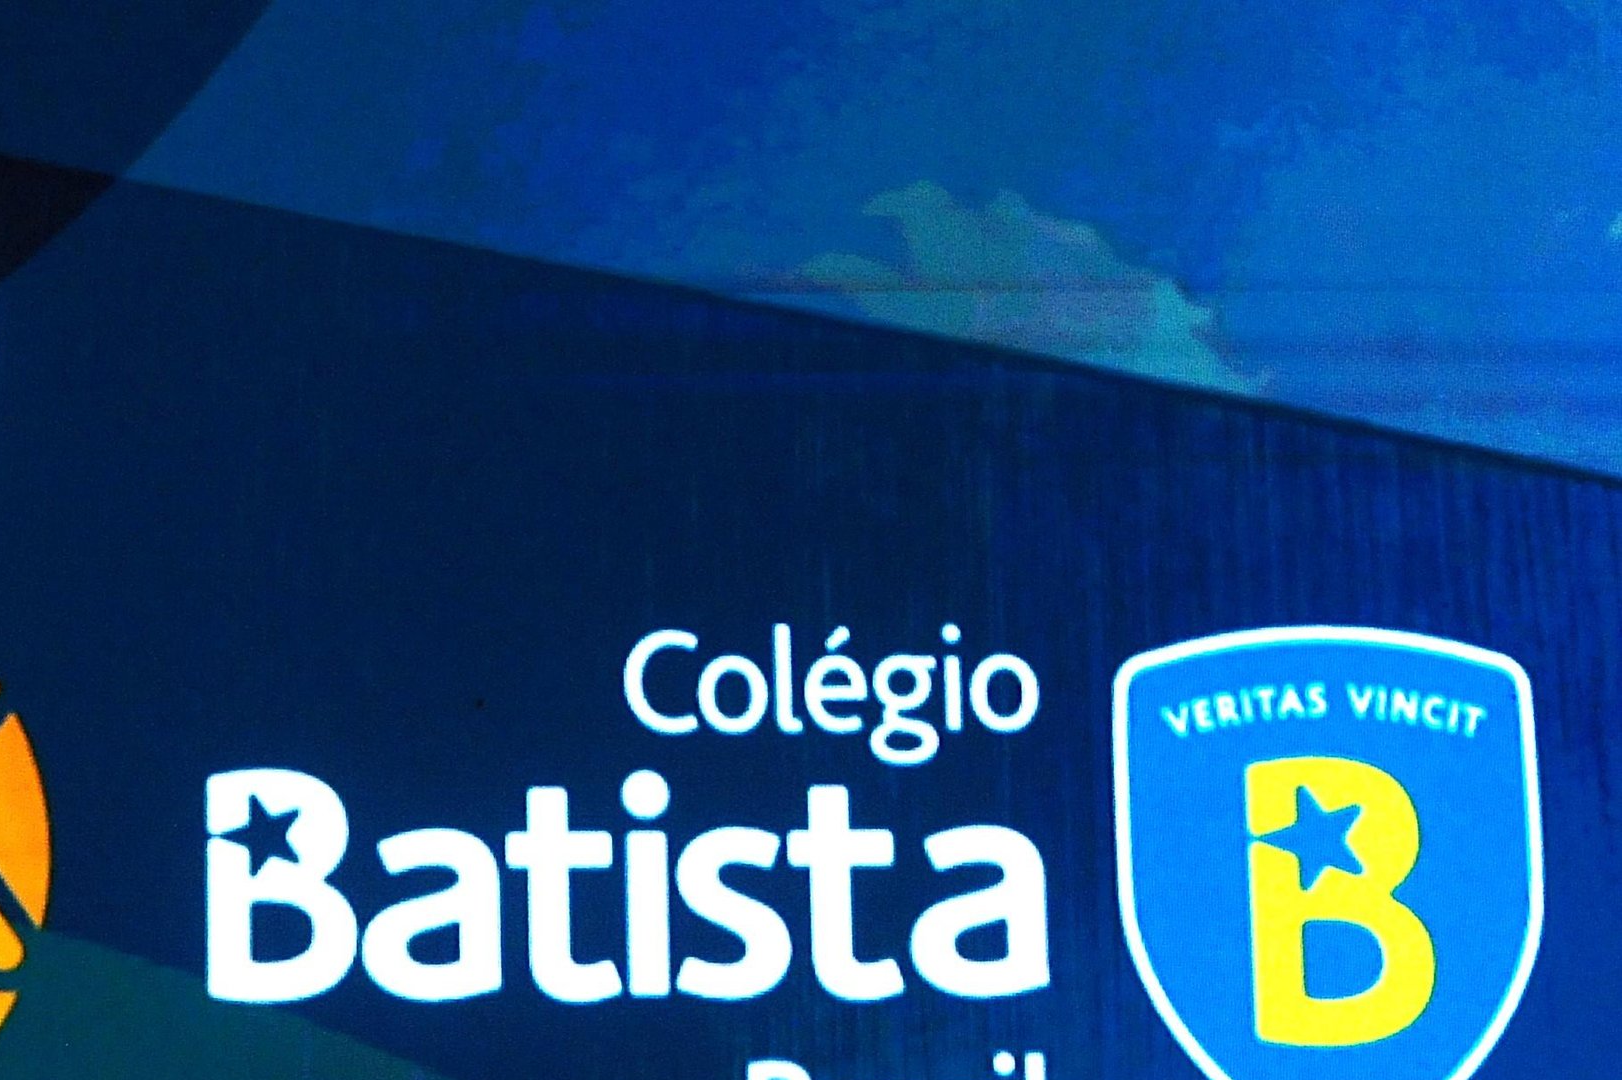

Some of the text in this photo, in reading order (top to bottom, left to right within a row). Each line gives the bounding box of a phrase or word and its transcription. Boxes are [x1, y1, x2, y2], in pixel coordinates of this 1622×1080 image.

[622, 623, 1040, 765] Colégio
[1161, 682, 1487, 738] VERITAS VINCIT
[206, 768, 1051, 1005] Batista
